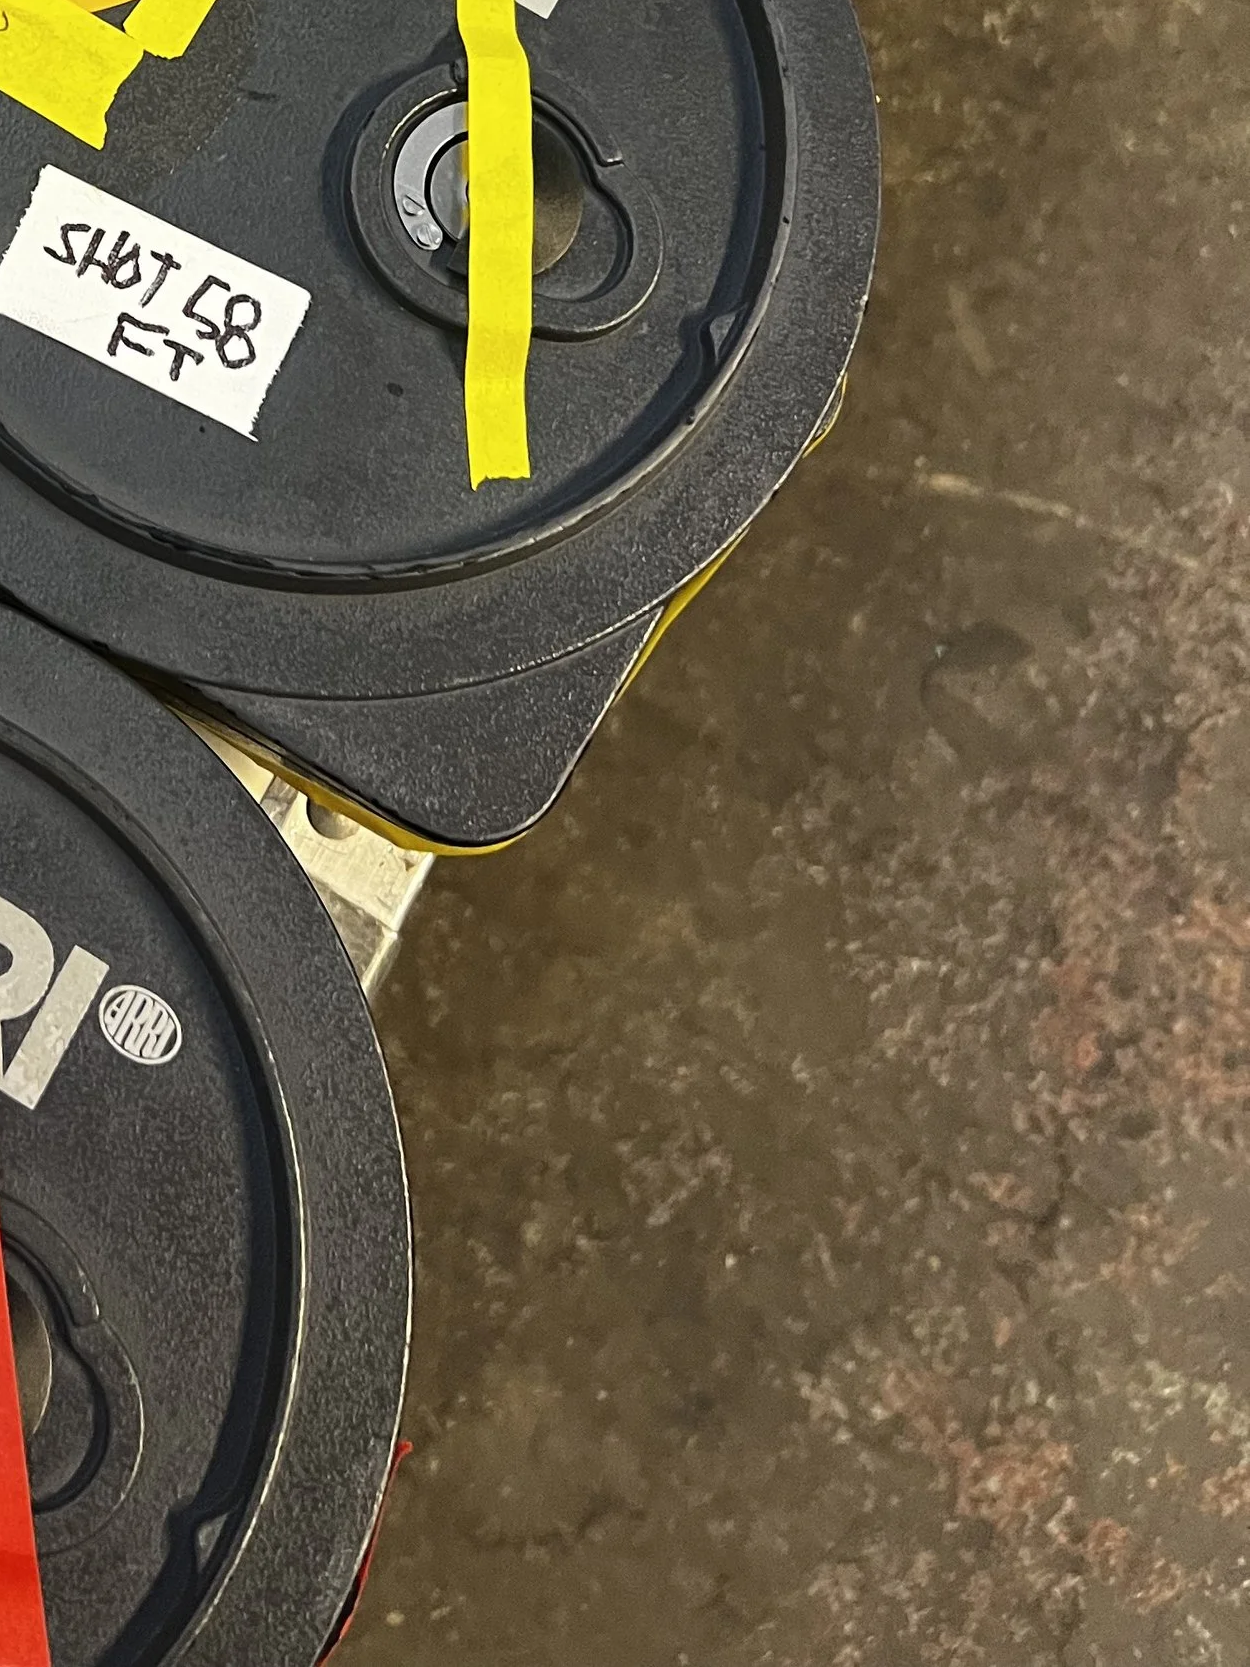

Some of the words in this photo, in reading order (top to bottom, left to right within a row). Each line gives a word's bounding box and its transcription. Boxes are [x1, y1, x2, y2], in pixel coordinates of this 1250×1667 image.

[42, 222, 181, 308] SHOT
[167, 274, 261, 369] 58
[106, 311, 204, 381] FT
[94, 981, 184, 1067] ARRI
